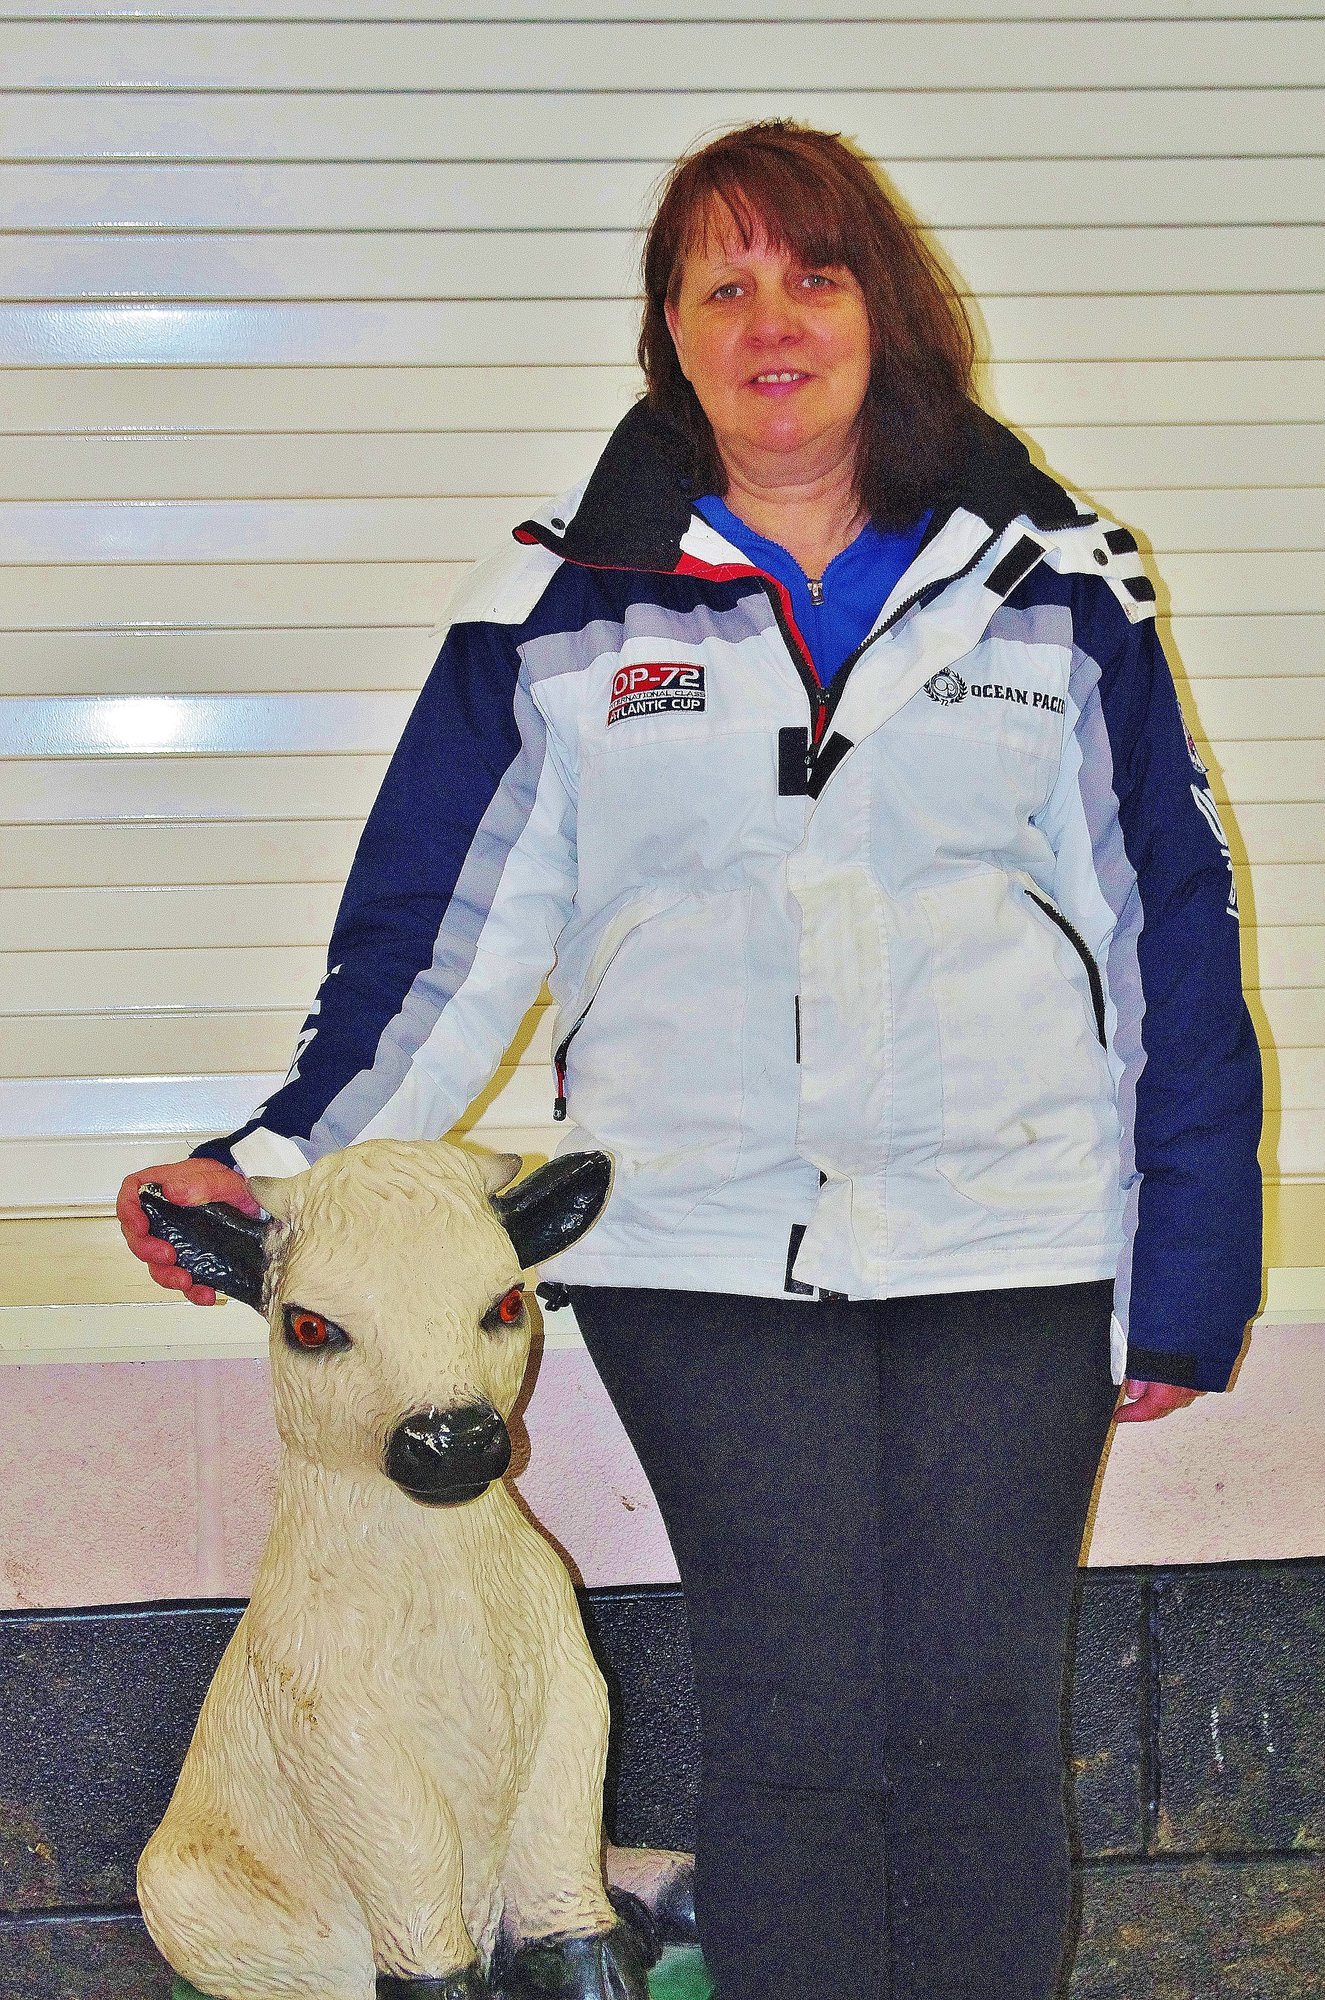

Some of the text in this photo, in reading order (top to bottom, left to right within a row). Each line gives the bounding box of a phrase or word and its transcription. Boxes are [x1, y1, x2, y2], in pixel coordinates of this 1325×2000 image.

[613, 666, 700, 696] OP-72
[970, 684, 1028, 705] OCEAN
[610, 698, 700, 722] ATLANTIC CUP
